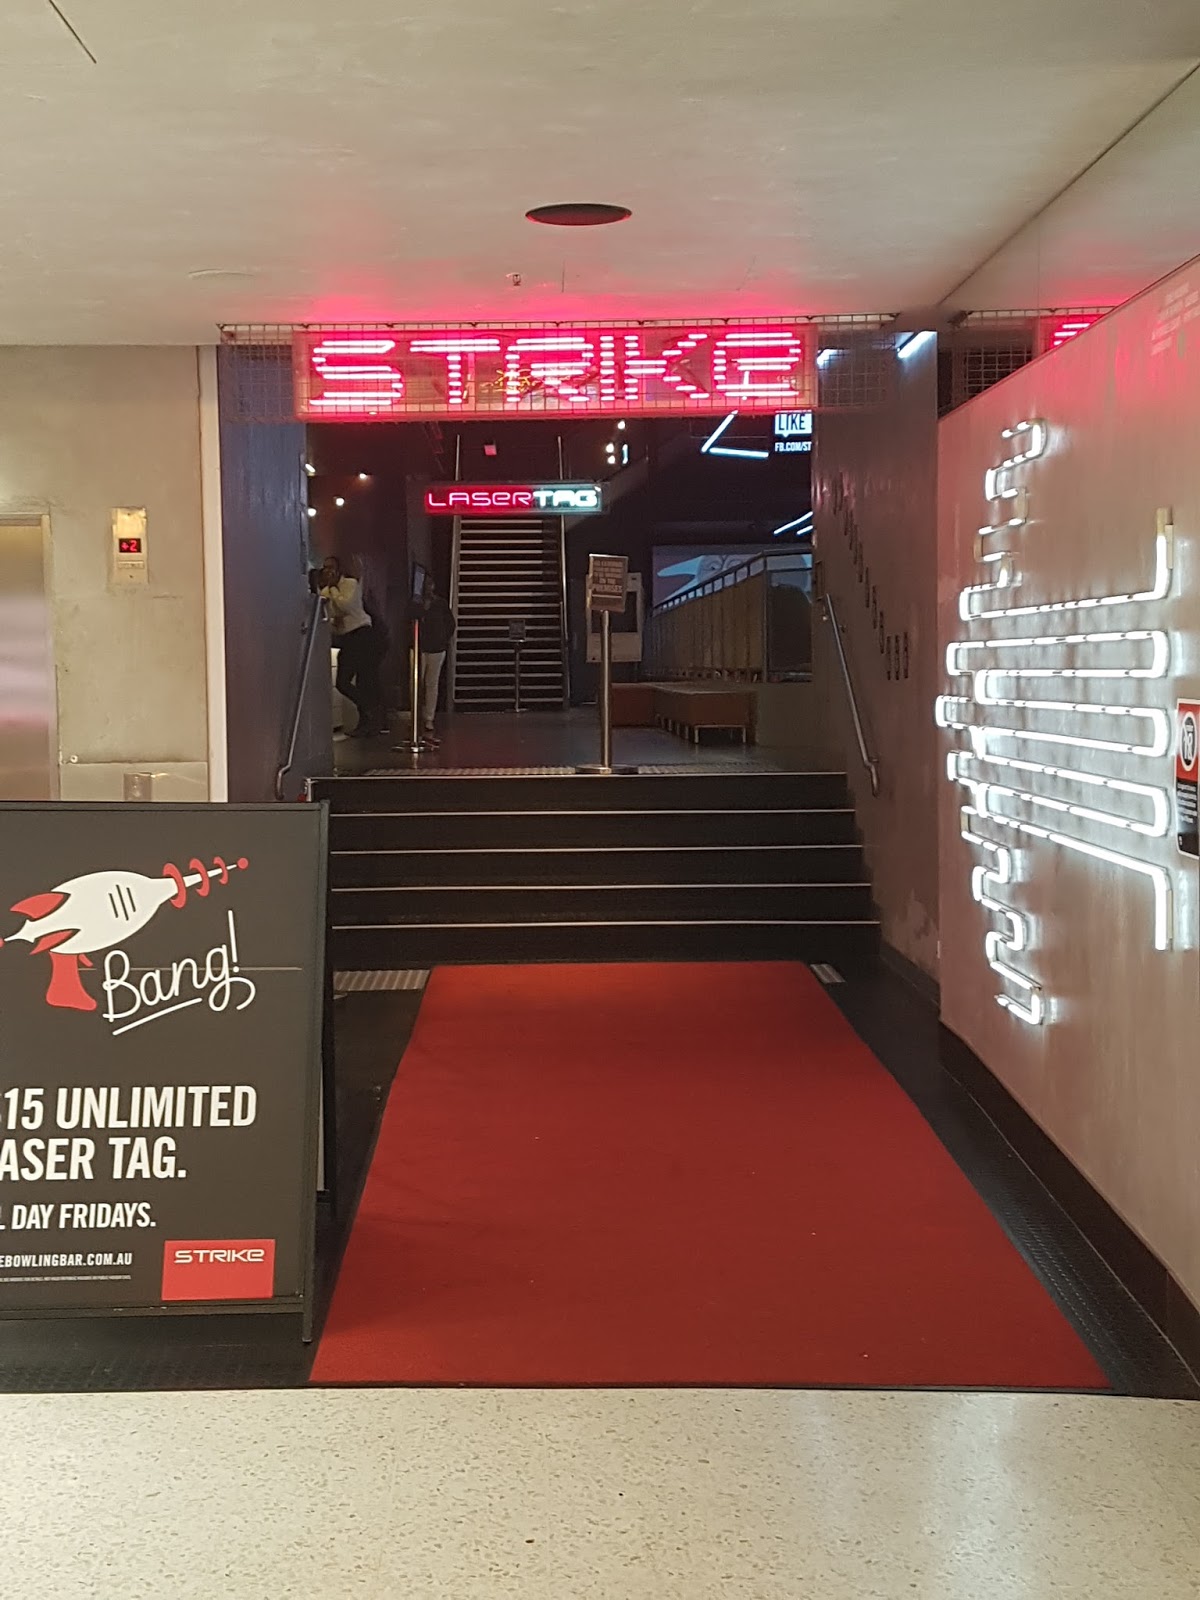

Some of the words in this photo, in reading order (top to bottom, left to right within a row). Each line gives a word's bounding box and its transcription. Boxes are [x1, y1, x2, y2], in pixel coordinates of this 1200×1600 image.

[309, 331, 802, 406] STRIKE
[778, 413, 806, 431] LIKE
[102, 909, 257, 1023] Bang!
[0, 1087, 45, 1131] 15
[56, 1085, 258, 1130] UNLIMITED
[108, 1135, 188, 1180] TAG.
[11, 1203, 54, 1230] DAY
[58, 1201, 157, 1229] FRIDAYS.
[173, 1248, 266, 1264] STRIKE
